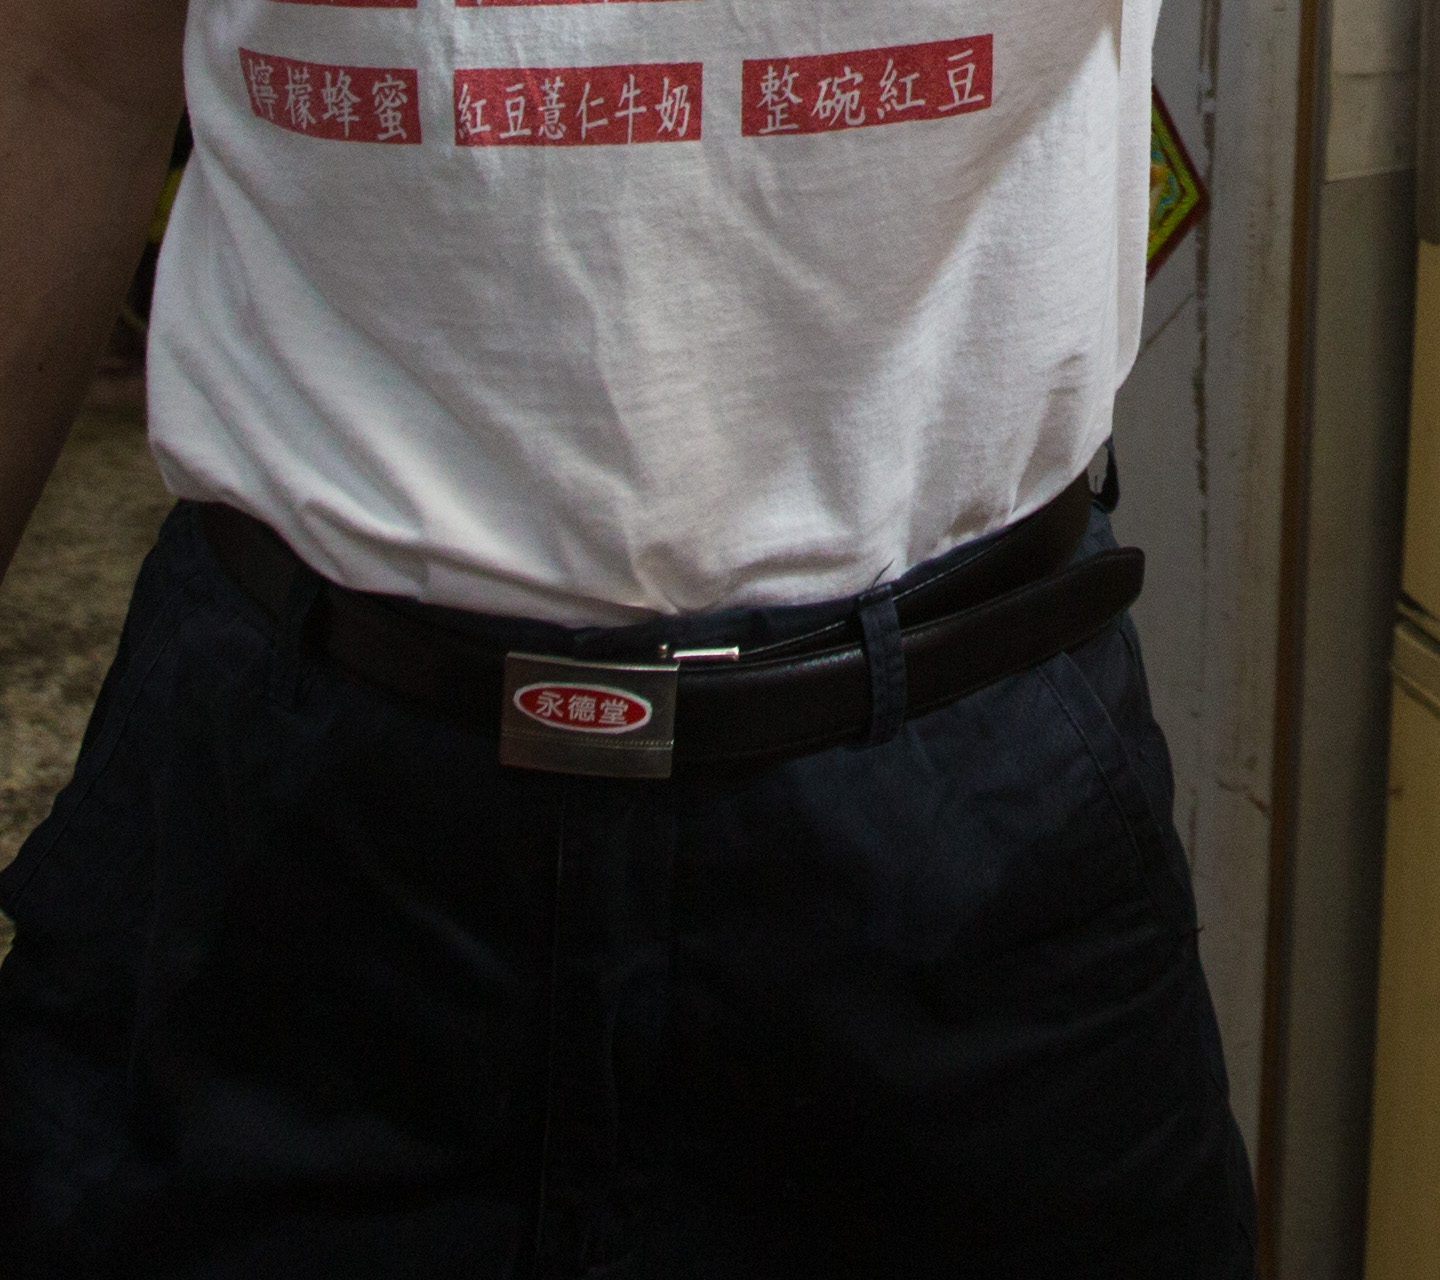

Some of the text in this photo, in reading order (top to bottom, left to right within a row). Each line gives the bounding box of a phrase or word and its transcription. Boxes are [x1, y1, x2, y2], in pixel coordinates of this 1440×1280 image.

[247, 57, 408, 141] 檸檬蜂蜜
[457, 72, 693, 144] 紅豆薏仁牛奶
[757, 48, 986, 135] 整碗紅豆
[535, 690, 630, 727] 永德堂
